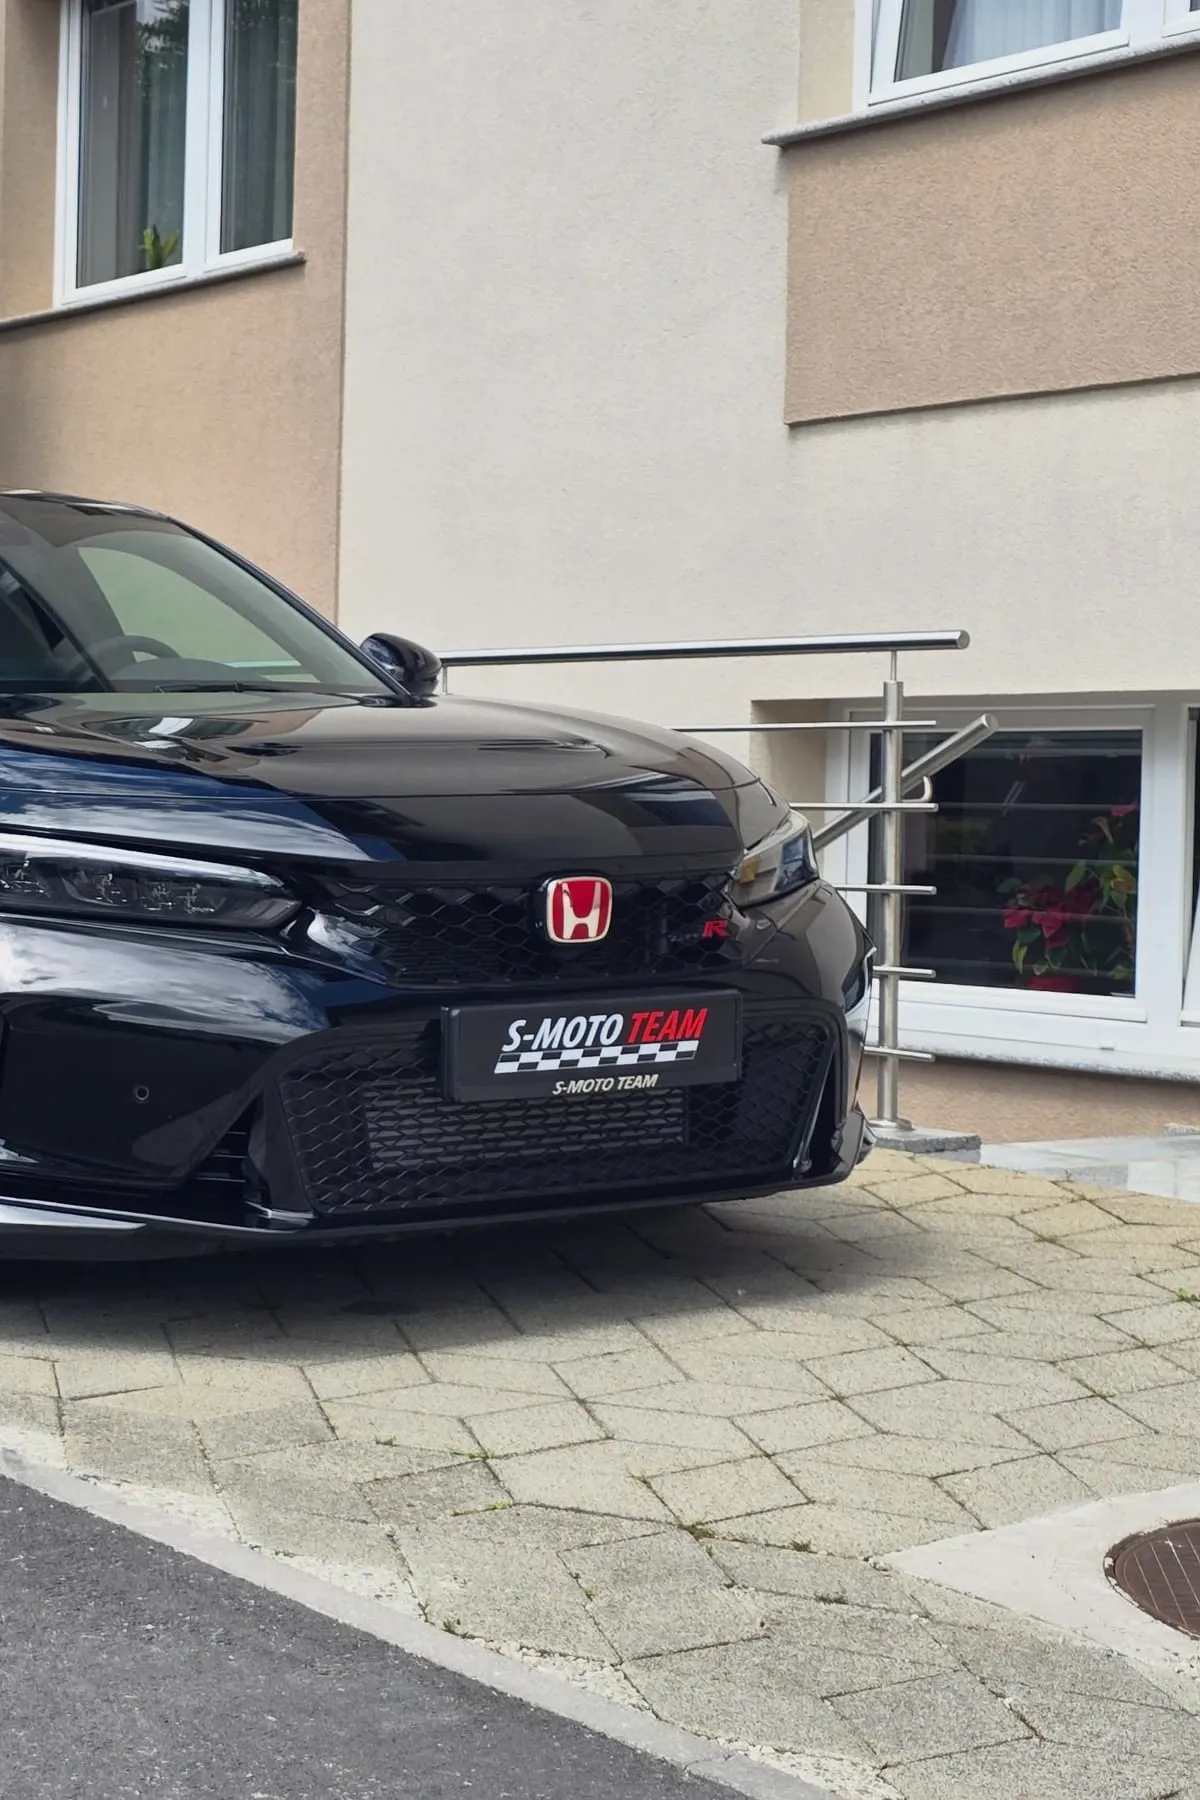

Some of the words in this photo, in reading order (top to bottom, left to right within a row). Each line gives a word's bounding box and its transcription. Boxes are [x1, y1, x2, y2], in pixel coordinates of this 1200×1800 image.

[702, 919, 729, 938] R
[502, 1013, 624, 1052] S-MOTO
[628, 1008, 708, 1044] TEAM
[552, 1076, 615, 1095] S-MOTO
[616, 1074, 659, 1091] TEAM
